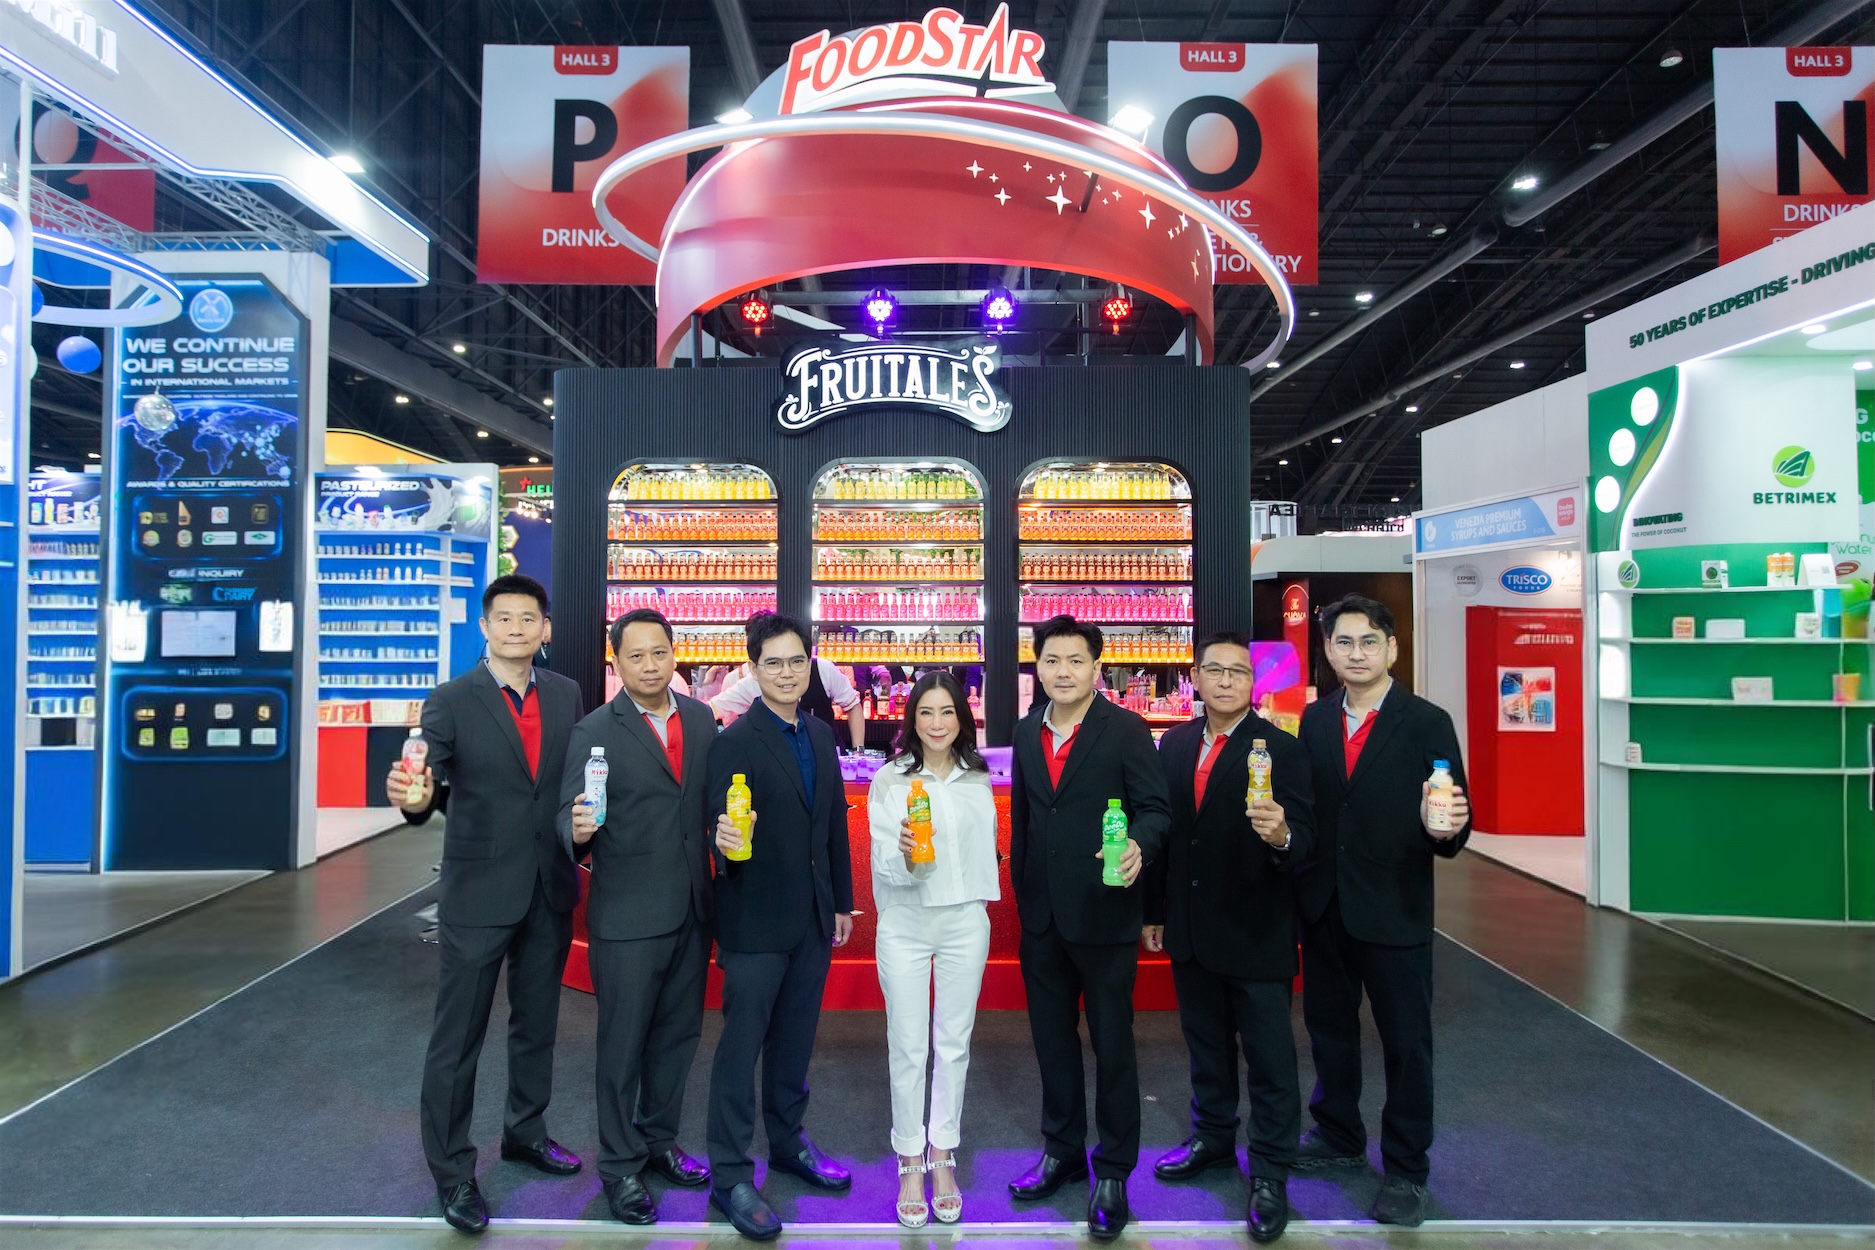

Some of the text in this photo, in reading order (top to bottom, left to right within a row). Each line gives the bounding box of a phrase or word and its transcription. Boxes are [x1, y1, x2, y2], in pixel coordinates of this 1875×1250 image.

[561, 53, 611, 66] HALL 3
[1187, 51, 1237, 63] HALL 3
[1794, 55, 1844, 68] HALL 3
[551, 98, 618, 193] P
[1162, 95, 1262, 192] O
[1774, 101, 1869, 196] N
[1629, 332, 1645, 348] 50
[1645, 316, 1687, 343] YEARS
[1688, 308, 1707, 327] OF
[1707, 276, 1789, 320] EXPERTISE
[1801, 241, 1875, 285] DRIVING
[126, 337, 295, 354] WE CONTINUE
[122, 357, 290, 373] OUR SUCCESS
[130, 377, 289, 386] IN INTERNATIONAL MARKETS
[218, 480, 290, 488] CERTIFICATIONS
[321, 481, 420, 491] PASTEURIZED
[1753, 492, 1837, 504] BETRIMEX
[1455, 508, 1522, 528] VENEZIA PREMIUM
[1451, 528, 1477, 541] SYRUPS
[1478, 525, 1496, 537] AND
[1496, 520, 1527, 535] SAUCES
[1663, 526, 1687, 535] COCONUT
[1836, 543, 1873, 555] Water
